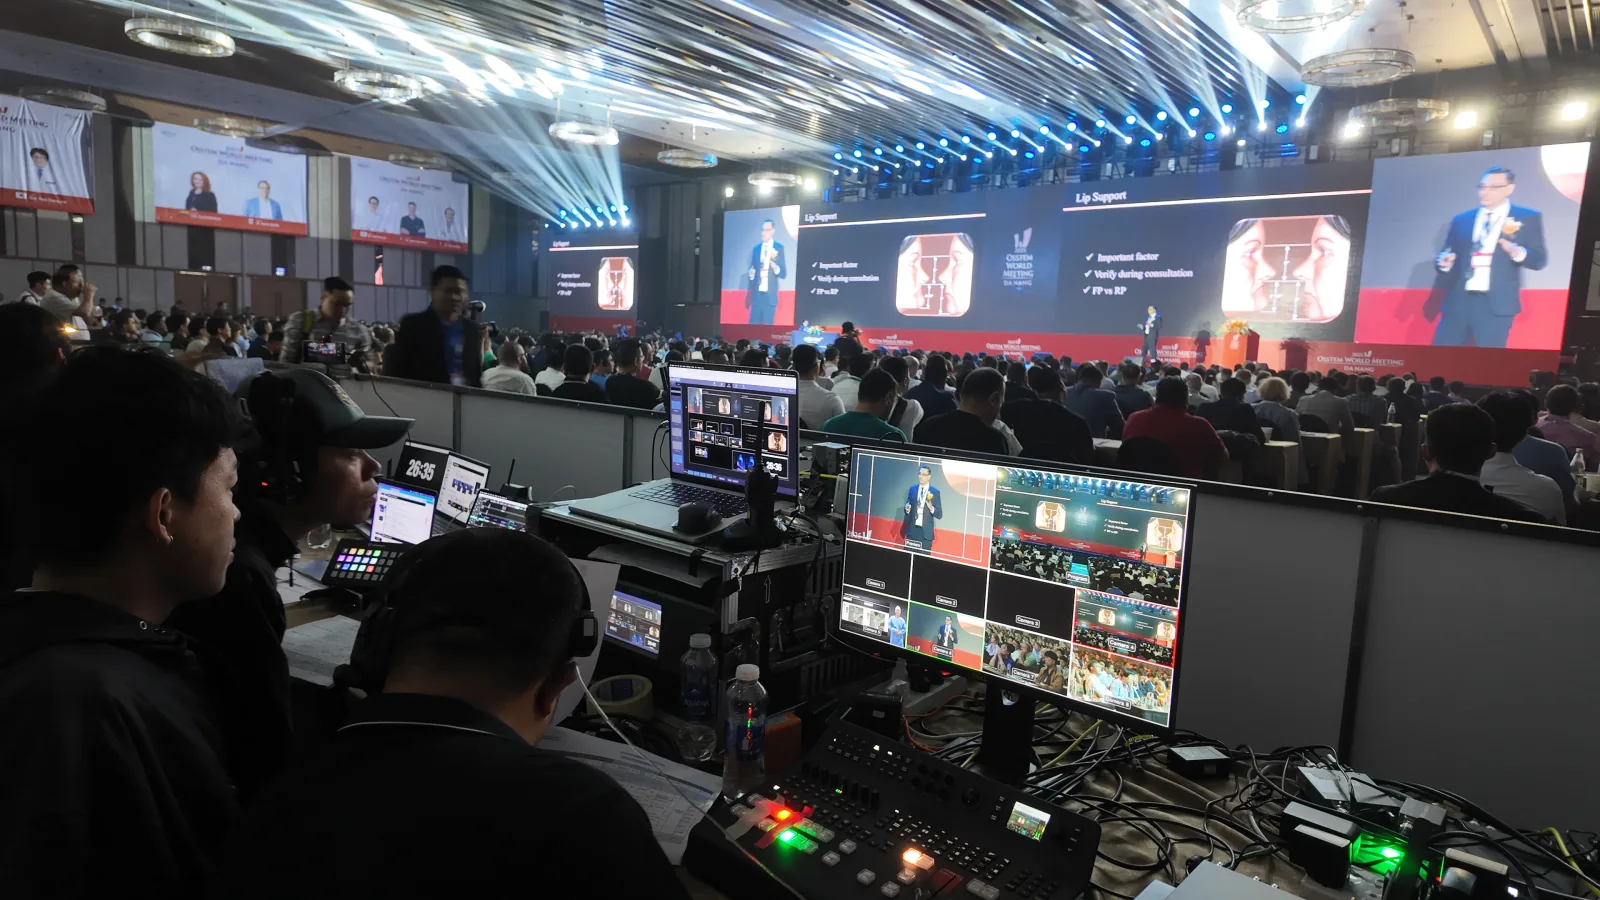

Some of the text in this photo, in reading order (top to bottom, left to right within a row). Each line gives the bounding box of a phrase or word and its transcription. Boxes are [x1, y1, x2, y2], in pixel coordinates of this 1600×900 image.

[1076, 191, 1127, 204] Lip Support
[804, 212, 838, 223] Lip Support
[1097, 252, 1159, 264] Important factor
[1002, 270, 1034, 278] MEETING
[1094, 268, 1194, 280] Verify during consultation
[1092, 287, 1104, 295] FP
[1114, 286, 1127, 295] RP
[406, 459, 436, 481] 26:35
[1068, 574, 1088, 582] Program
[937, 596, 952, 605] Camera
[1018, 617, 1034, 625] Camera
[1110, 640, 1129, 649] Camera
[933, 646, 948, 655] Camera
[1013, 669, 1031, 678] Camera
